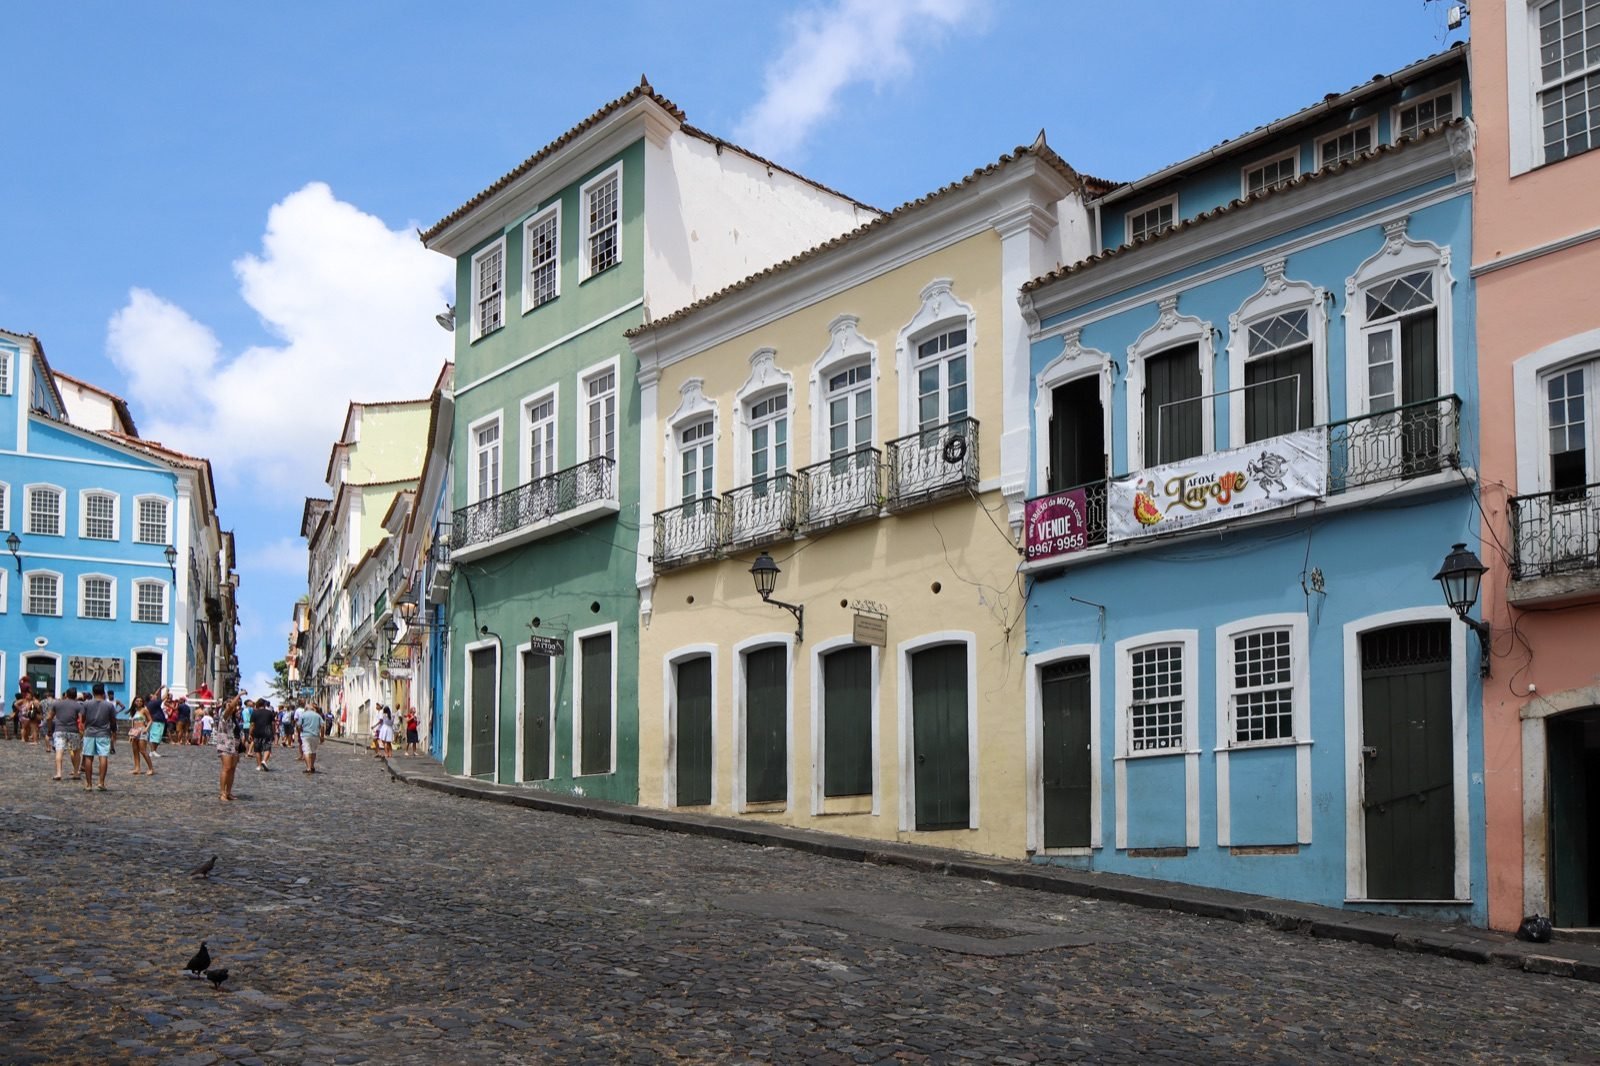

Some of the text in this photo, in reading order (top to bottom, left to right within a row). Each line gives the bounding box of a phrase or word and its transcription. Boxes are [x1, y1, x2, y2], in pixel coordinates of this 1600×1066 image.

[1187, 472, 1216, 488] AFOXÉ
[1037, 515, 1071, 541] VENDE
[1028, 533, 1084, 557] 9967-9955
[533, 641, 556, 650] TATTOO
